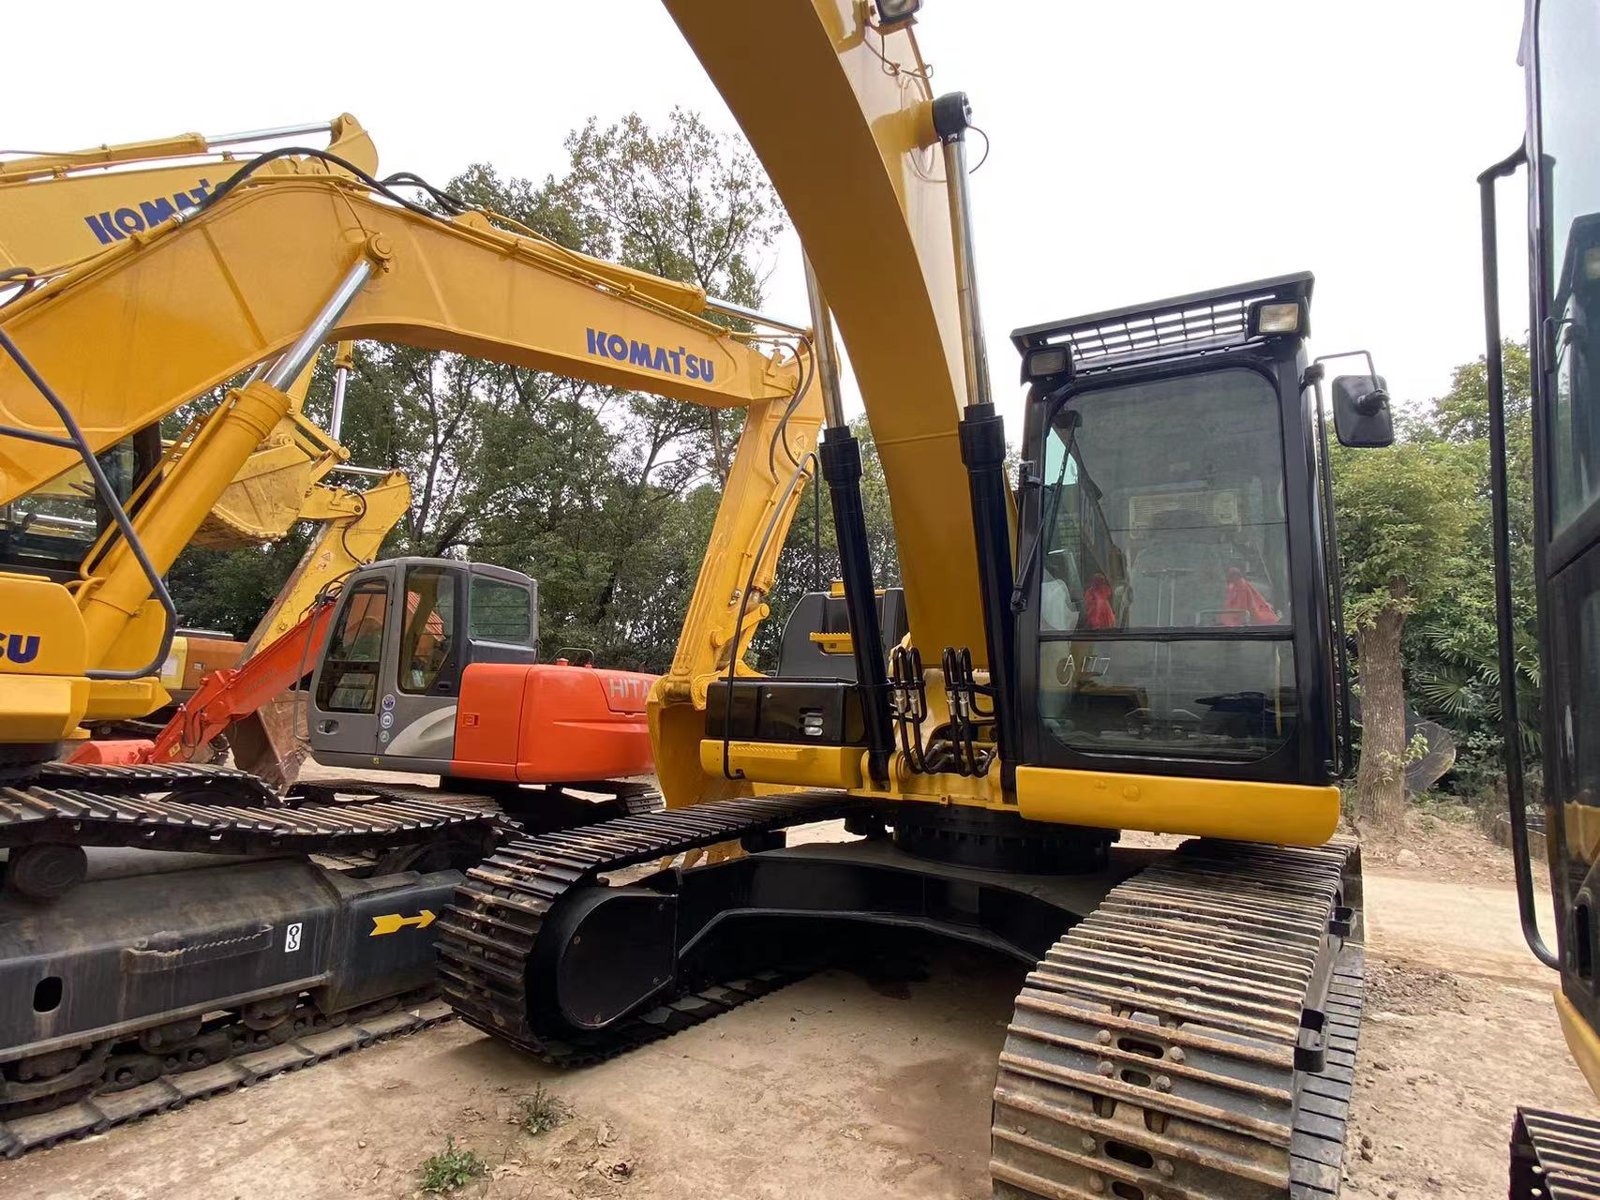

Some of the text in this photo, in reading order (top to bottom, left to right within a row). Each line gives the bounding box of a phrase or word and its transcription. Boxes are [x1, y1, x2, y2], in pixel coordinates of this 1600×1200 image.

[84, 178, 228, 245] KOMAT
[586, 327, 714, 383] KOMATSU
[0, 632, 41, 664] U
